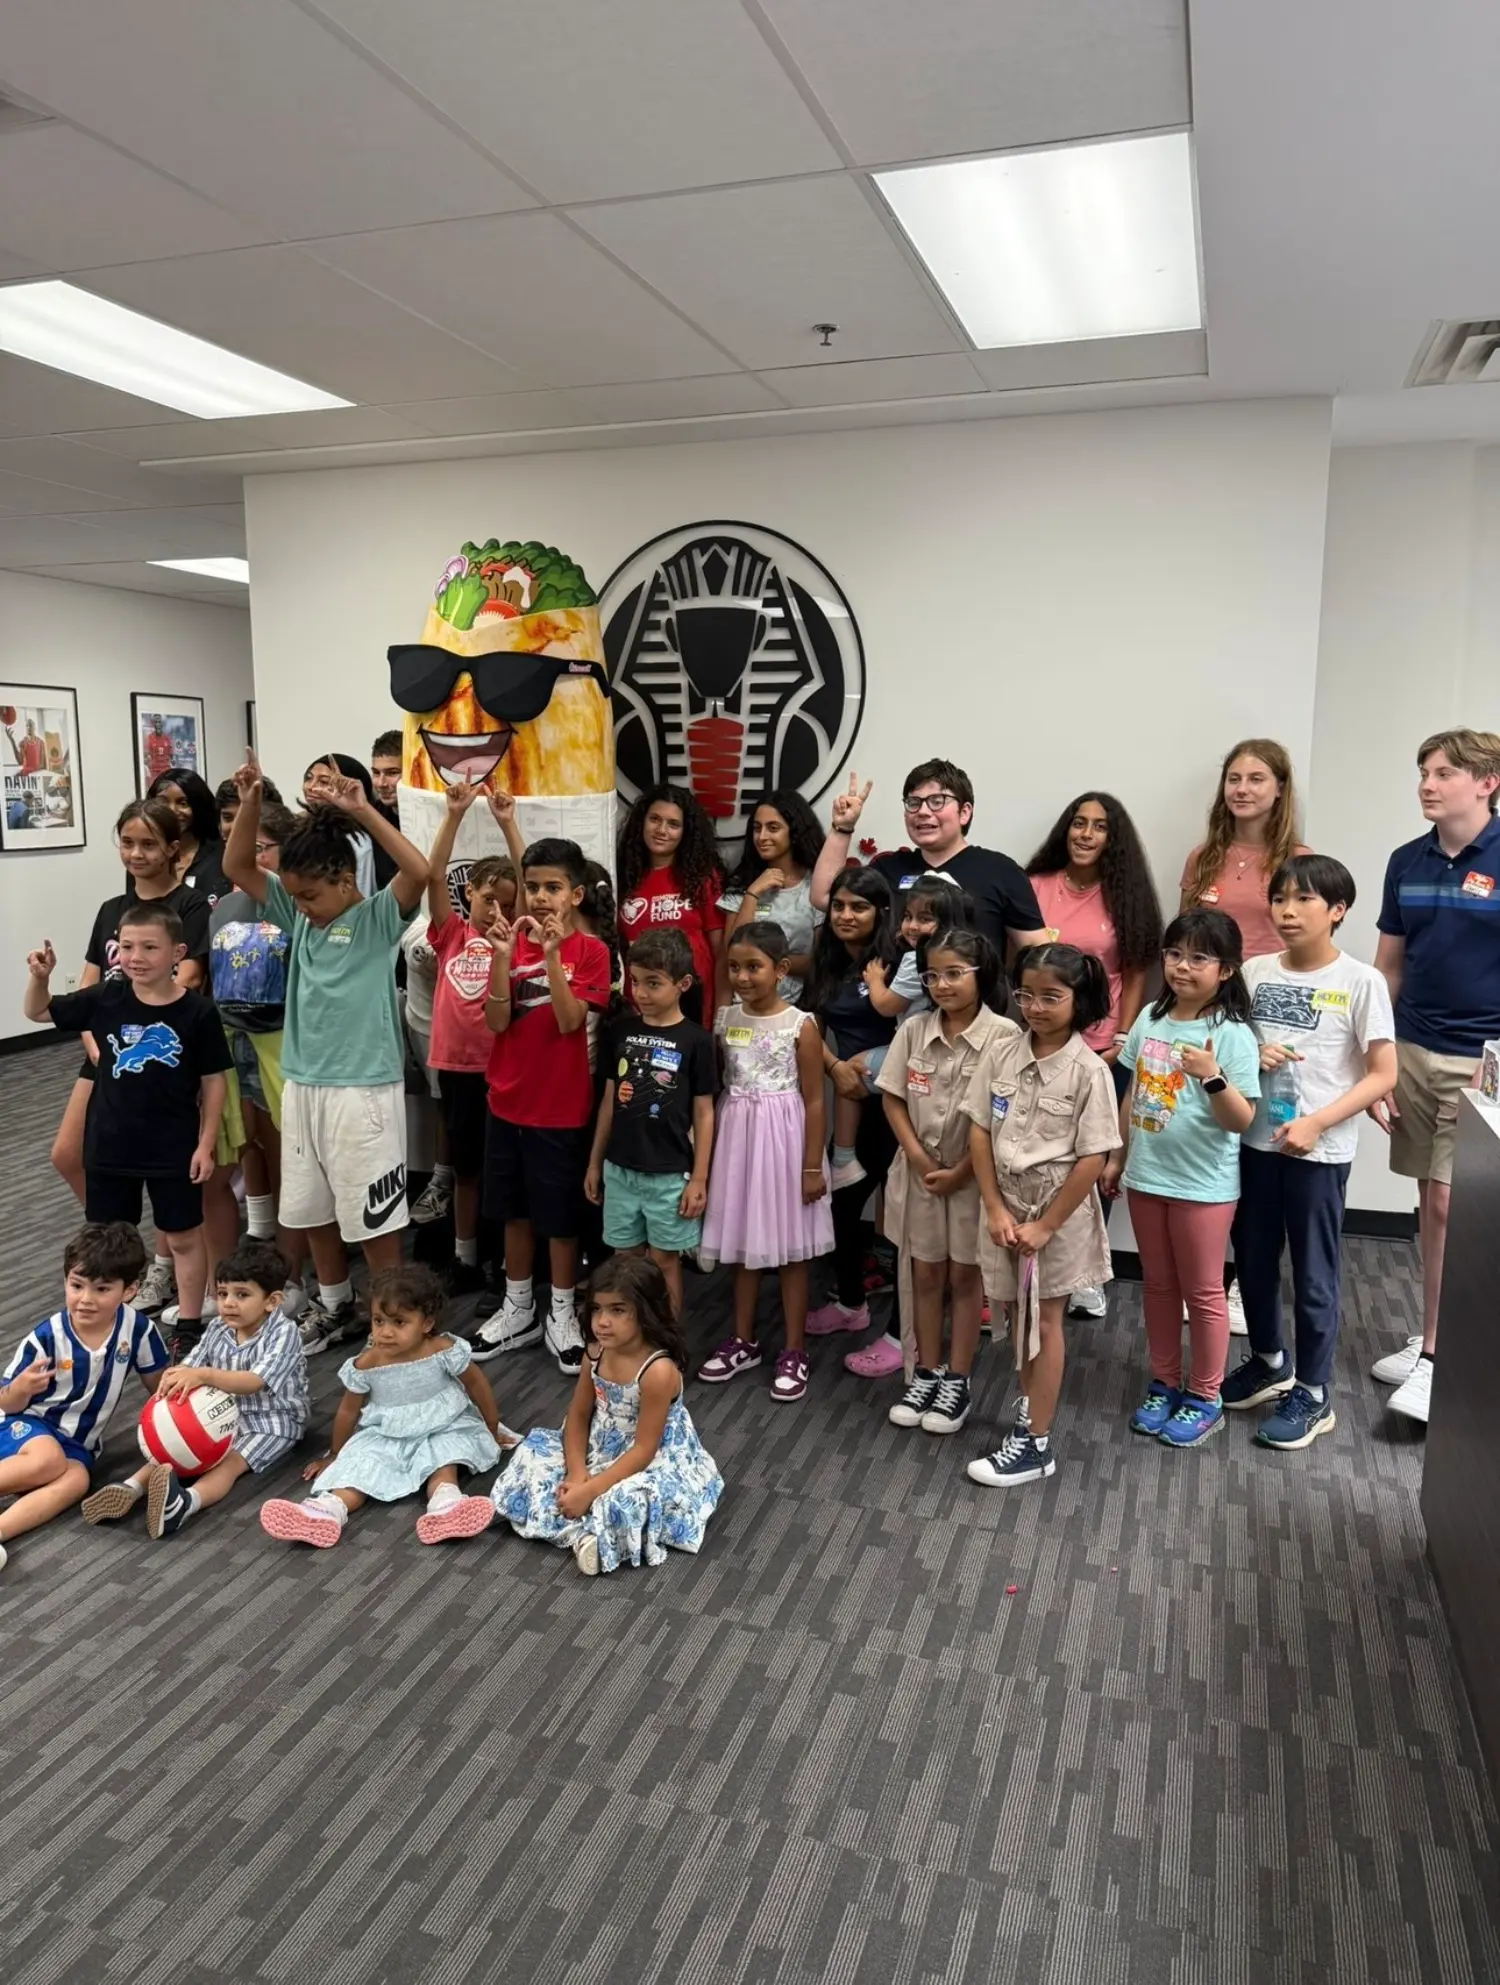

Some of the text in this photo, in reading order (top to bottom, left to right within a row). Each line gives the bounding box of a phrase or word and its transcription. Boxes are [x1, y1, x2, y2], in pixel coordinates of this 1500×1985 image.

[651, 898, 693, 913] HOPE
[651, 910, 682, 923] FUND
[626, 1036, 647, 1045] SOLAR
[648, 1039, 677, 1049] SYSTEM
[368, 1162, 406, 1210] NIK
